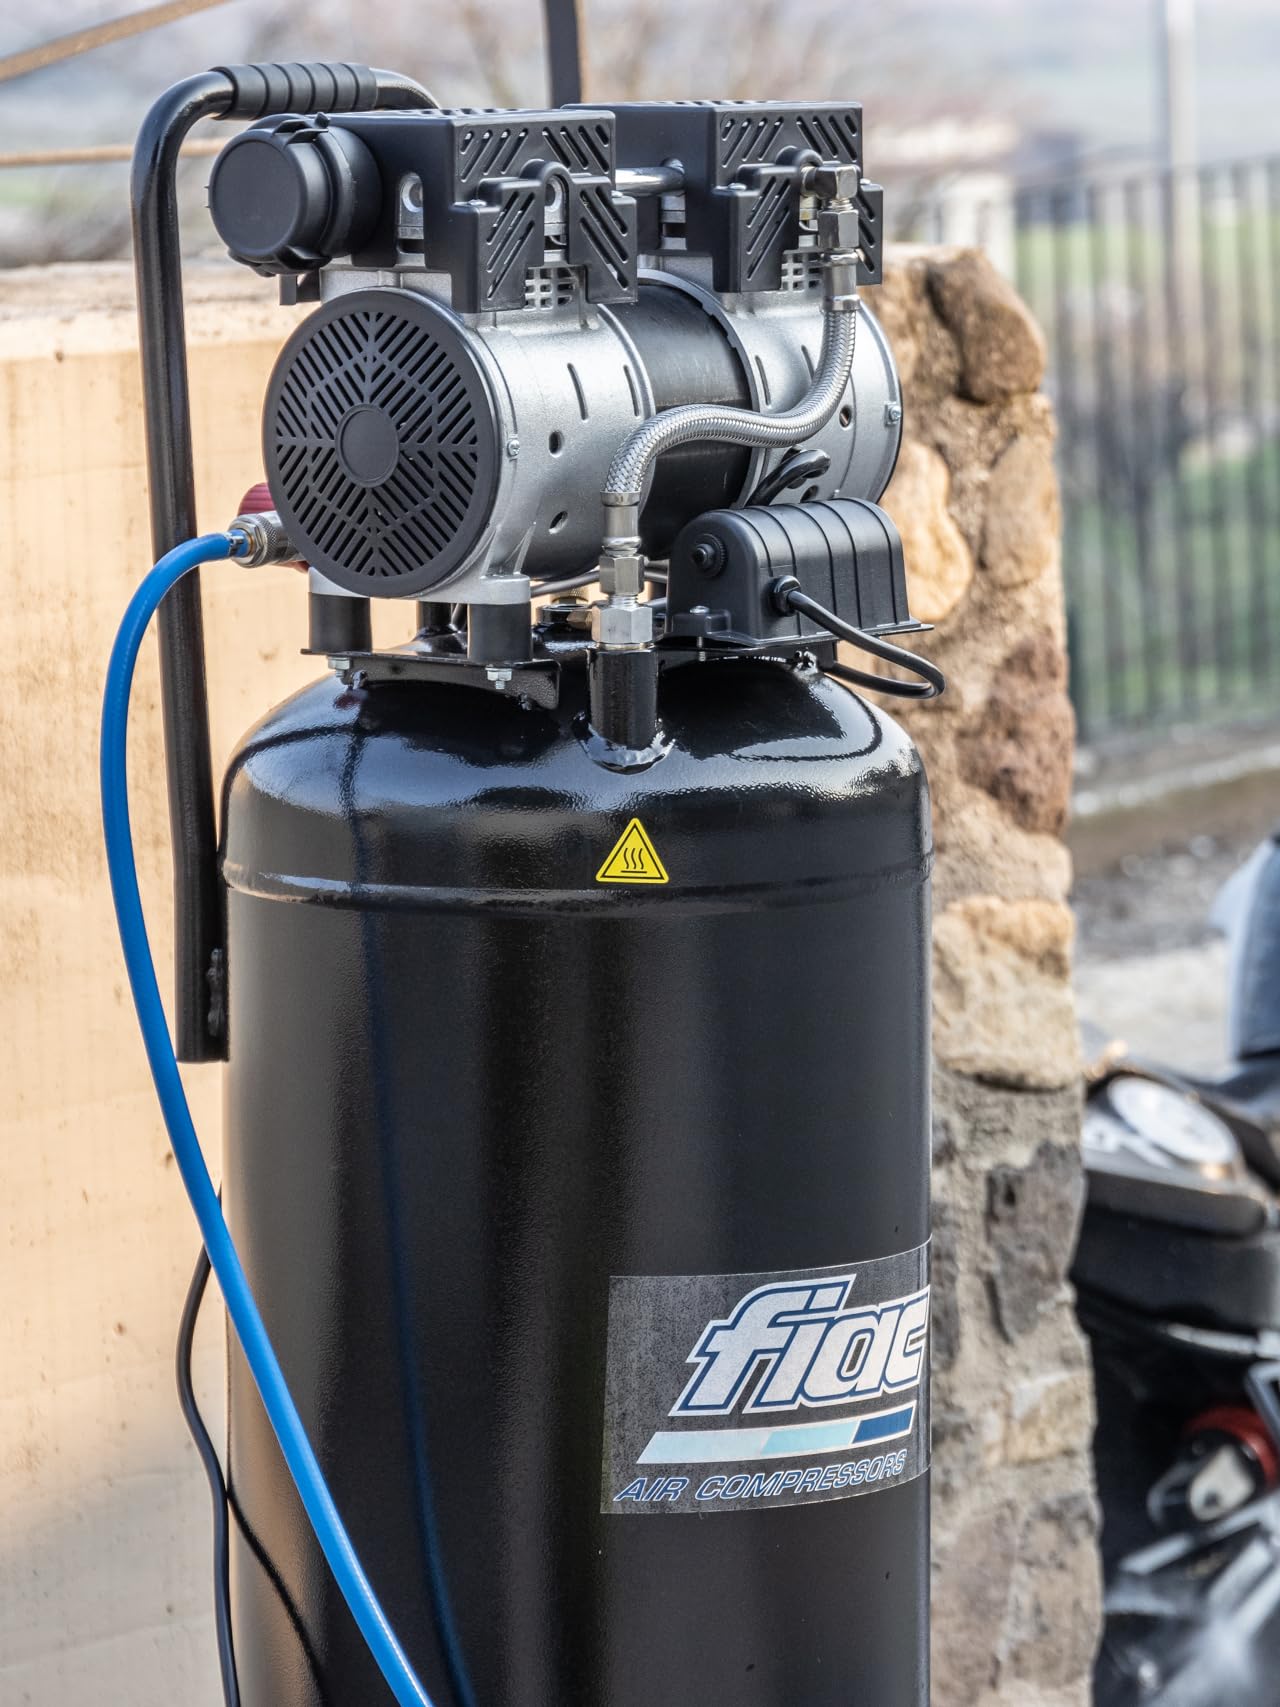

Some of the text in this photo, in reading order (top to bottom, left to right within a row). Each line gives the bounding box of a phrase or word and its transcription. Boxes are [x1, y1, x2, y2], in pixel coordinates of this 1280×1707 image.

[668, 1274, 931, 1417] fiac
[613, 1449, 908, 1502] AIR COMPRESSORS
